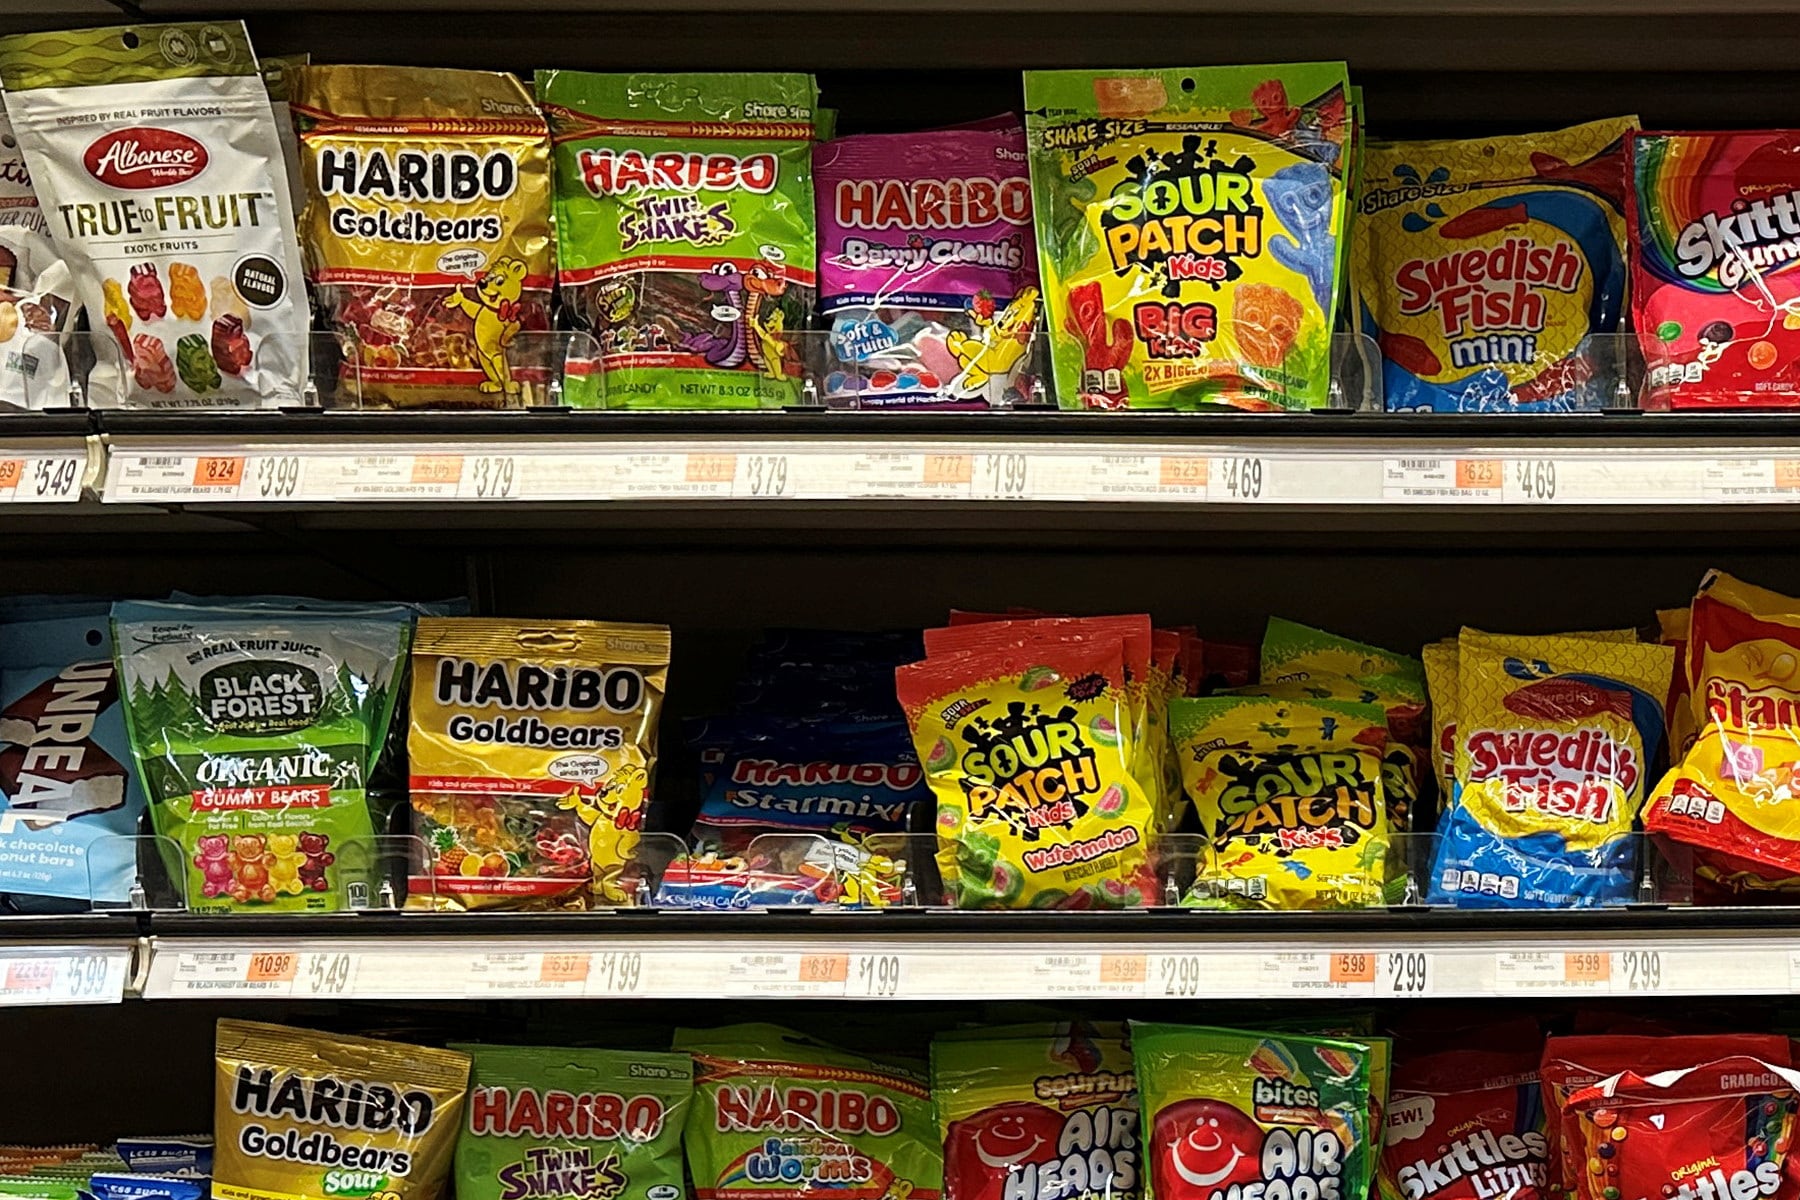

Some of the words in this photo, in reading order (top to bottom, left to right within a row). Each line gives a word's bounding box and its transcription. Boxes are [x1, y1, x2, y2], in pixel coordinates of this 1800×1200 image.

[114, 111, 137, 120] REAL
[140, 109, 170, 118] FRUIT
[173, 107, 221, 117] FLAVORS
[1044, 125, 1098, 149] SHARE
[1105, 120, 1147, 139] SIZE
[98, 139, 197, 175] Albanese
[322, 150, 516, 199] HARIBO
[581, 151, 776, 194] HARIBO
[60, 200, 142, 239] TRUE
[138, 206, 154, 223] to
[155, 193, 260, 233] FRUIT
[838, 178, 1032, 230] HARIBO
[1113, 172, 1249, 220] SOUR
[332, 206, 501, 244] Goldbears
[1107, 217, 1259, 268] PATCH
[123, 243, 157, 254] EXOTIC
[160, 241, 199, 252] FRUITS
[845, 242, 926, 273] Berry
[931, 238, 1022, 269] Clouds
[1168, 255, 1227, 281] Kids
[1396, 240, 1582, 312] Swedish
[1442, 285, 1542, 337] Fish
[837, 323, 867, 346] Soft
[870, 323, 882, 337] &
[842, 335, 894, 361] Fruity
[1450, 334, 1534, 367] mini
[203, 641, 237, 659] REAL
[239, 639, 277, 653] FRUIT
[282, 641, 322, 657] JUICE
[211, 694, 311, 718] FOREST
[214, 674, 304, 697] BLACK
[438, 662, 641, 711] HARIBO
[449, 718, 622, 749] Goldbears
[964, 722, 1079, 778] SOUR
[1469, 730, 1637, 784] Swedish
[202, 791, 264, 808] GUMMY
[270, 789, 320, 806] BEARS
[732, 789, 893, 822] Starmix
[969, 760, 1096, 815] PATCH
[1500, 769, 1609, 822] Fish
[1024, 827, 1136, 872] Watermelon
[234, 1065, 434, 1133] HARIBO
[472, 1090, 663, 1139] HARIBO
[718, 1087, 899, 1134] HARIBO
[1256, 1081, 1318, 1106] bites
[241, 1129, 411, 1176] Goldbears
[530, 1150, 590, 1170] TWIN
[747, 1154, 871, 1183] Worms
[1262, 1131, 1341, 1177] AIR
[500, 1158, 627, 1200] SNAKES
